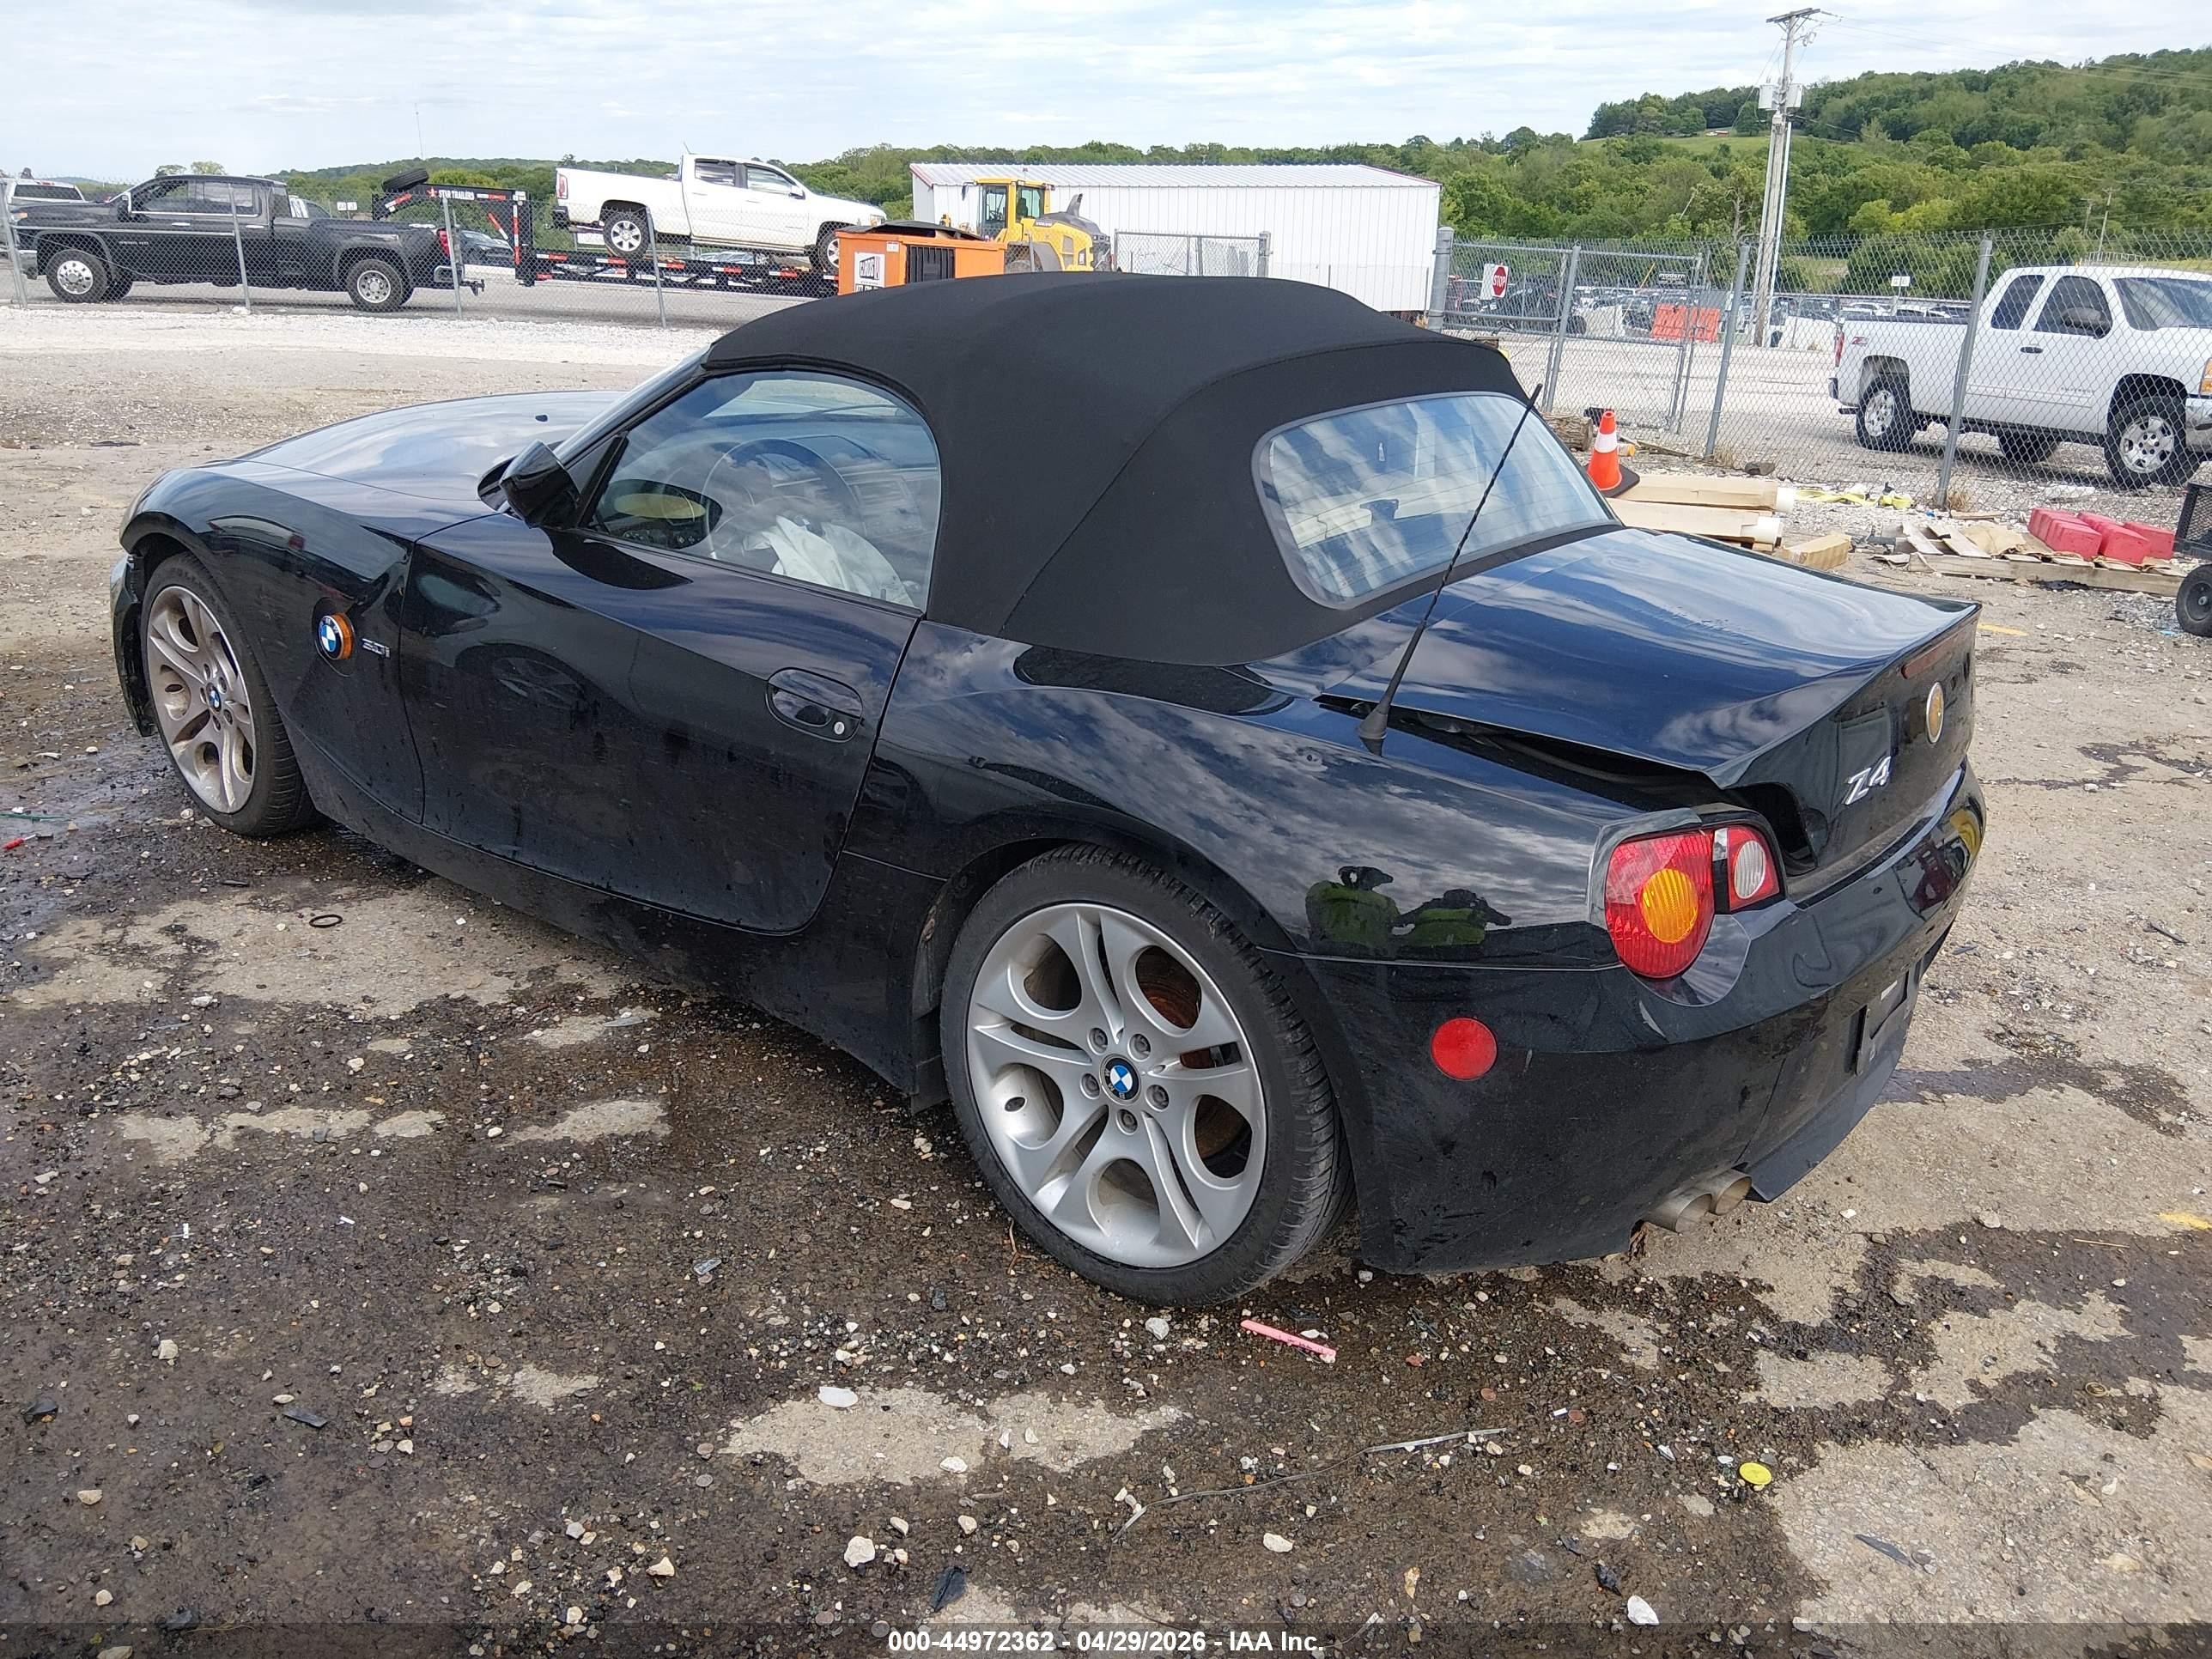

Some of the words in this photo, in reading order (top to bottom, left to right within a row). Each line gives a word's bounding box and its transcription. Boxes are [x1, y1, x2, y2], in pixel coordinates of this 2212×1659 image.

[438, 189, 452, 198] STAR
[452, 190, 475, 200] TRAILERS
[1493, 275, 1506, 289] STOP
[1841, 756, 1892, 805] Z4
